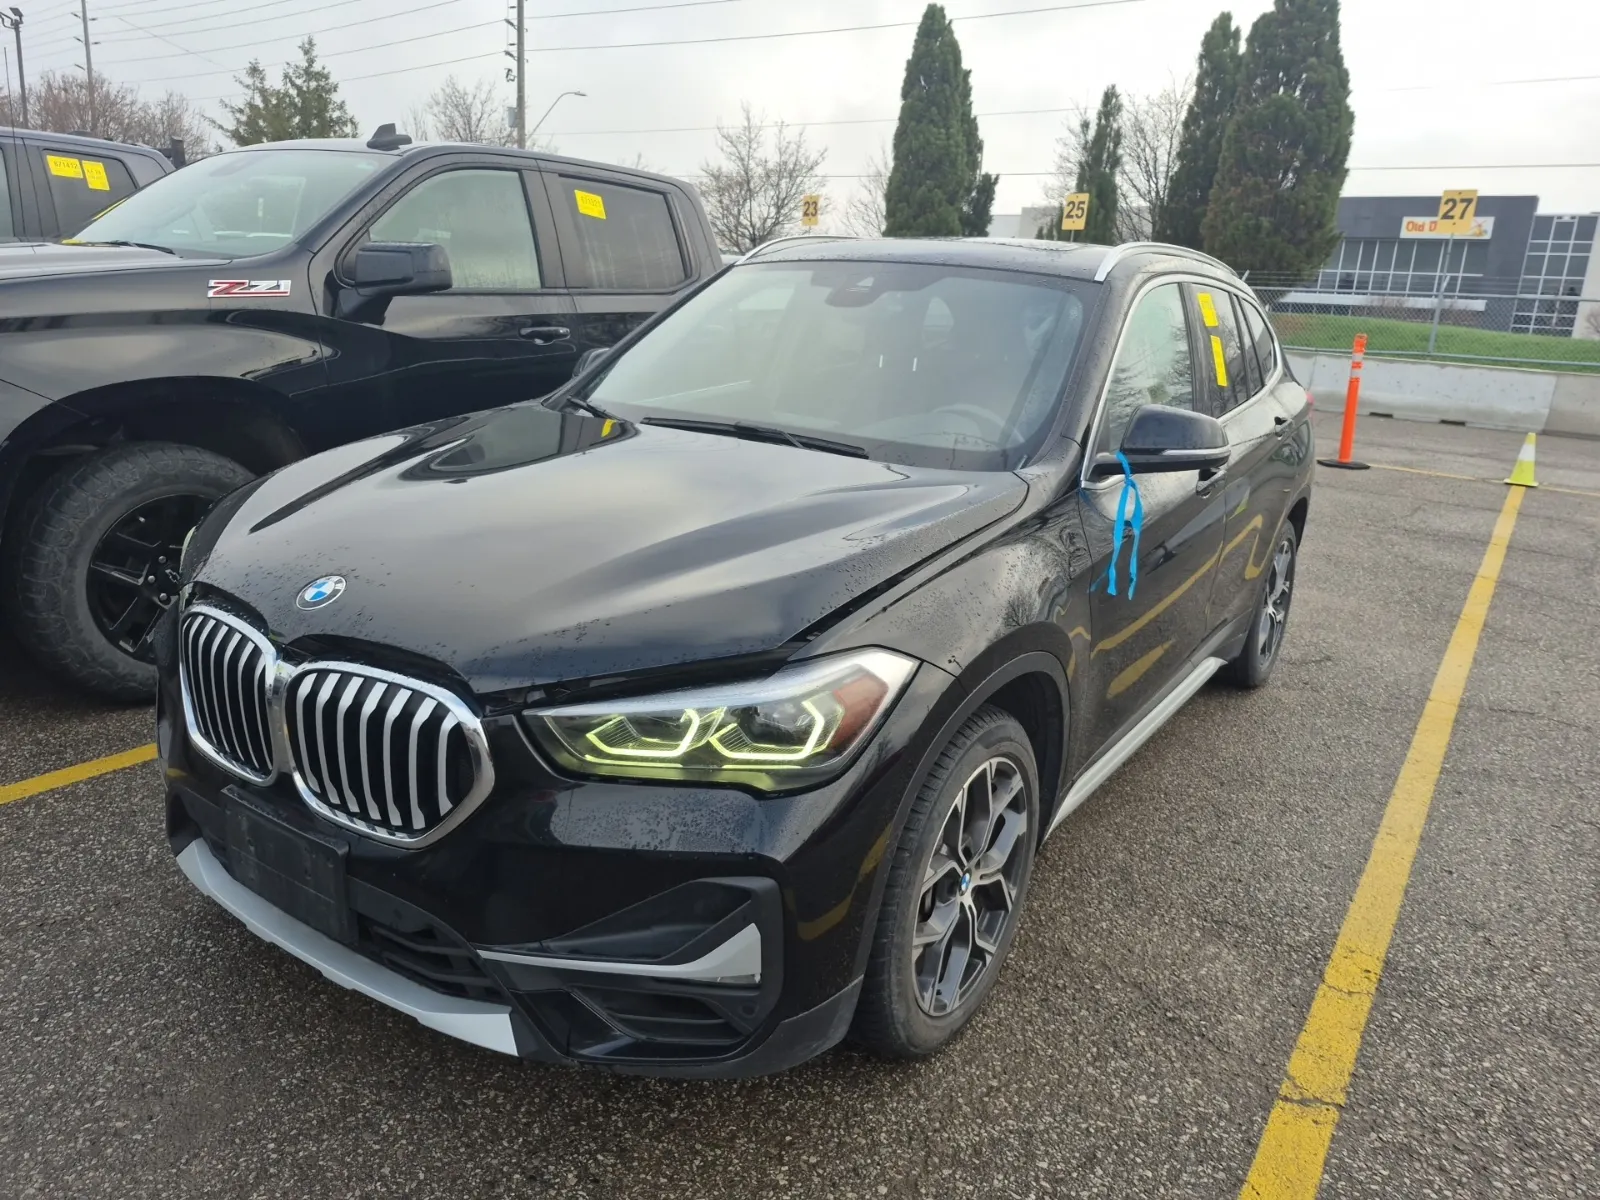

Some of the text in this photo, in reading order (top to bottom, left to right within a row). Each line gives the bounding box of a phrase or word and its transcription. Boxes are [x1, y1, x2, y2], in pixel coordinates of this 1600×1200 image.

[803, 201, 818, 217] 23
[1065, 200, 1086, 219] 25
[1440, 198, 1474, 220] 27
[1406, 220, 1426, 232] Old
